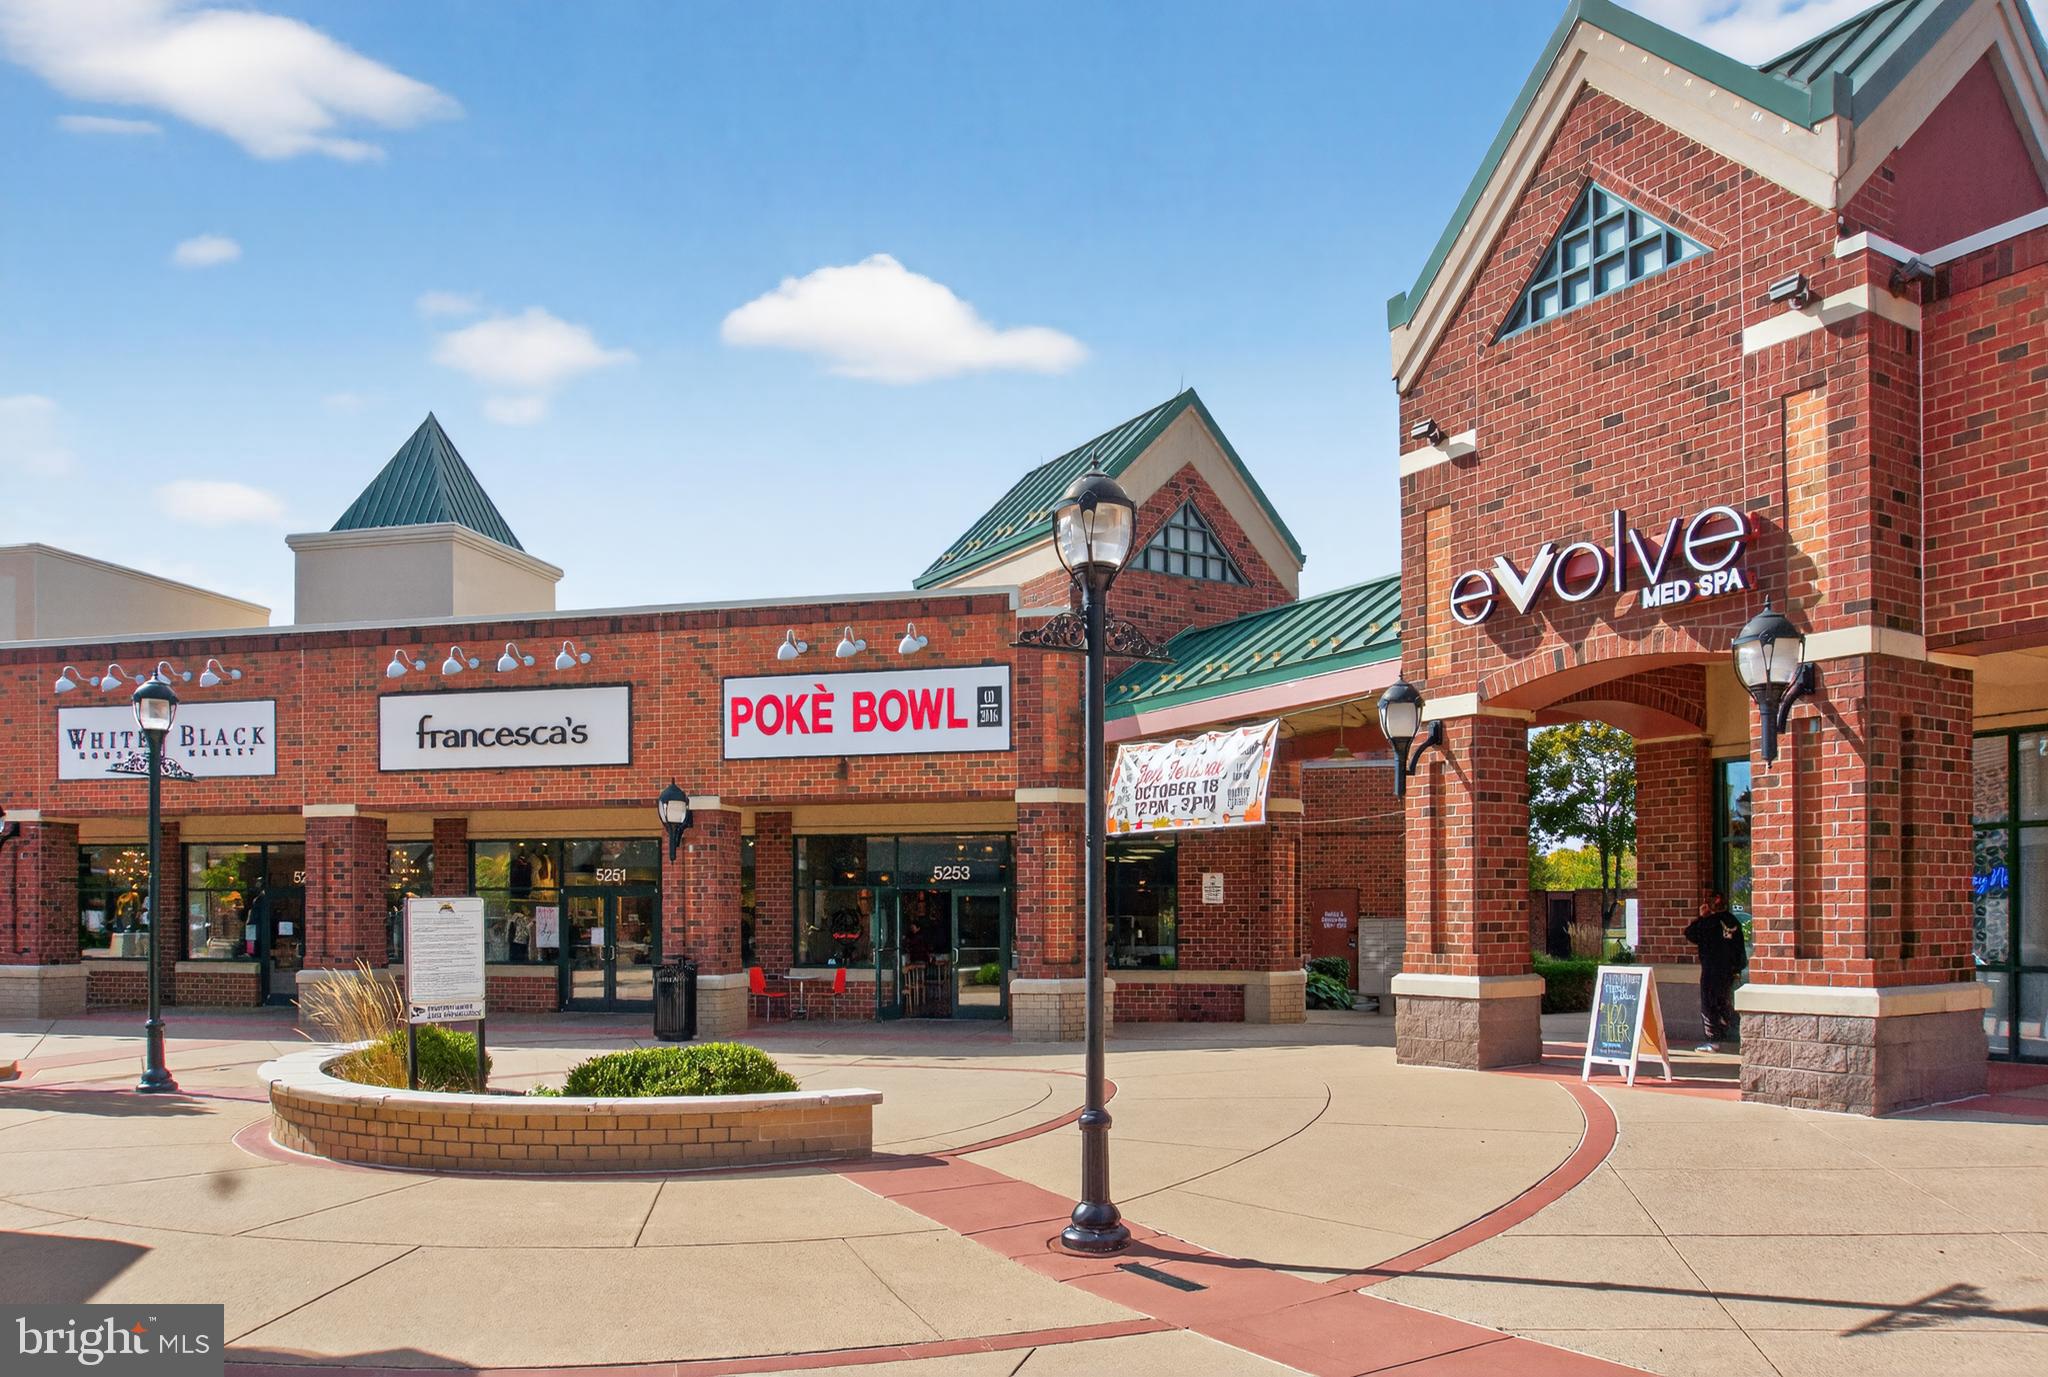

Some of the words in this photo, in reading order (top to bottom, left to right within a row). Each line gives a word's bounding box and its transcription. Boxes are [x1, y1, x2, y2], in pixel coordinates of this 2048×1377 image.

[1642, 579, 1691, 609] MED
[1700, 567, 1745, 596] SPA
[730, 683, 835, 737] POKÈ
[852, 687, 968, 733] BOWL
[180, 725, 265, 747] BLACK
[416, 714, 588, 749] francesca's
[1135, 780, 1196, 800] OCTOBER
[1202, 778, 1219, 794] 18
[933, 865, 971, 881] 5253
